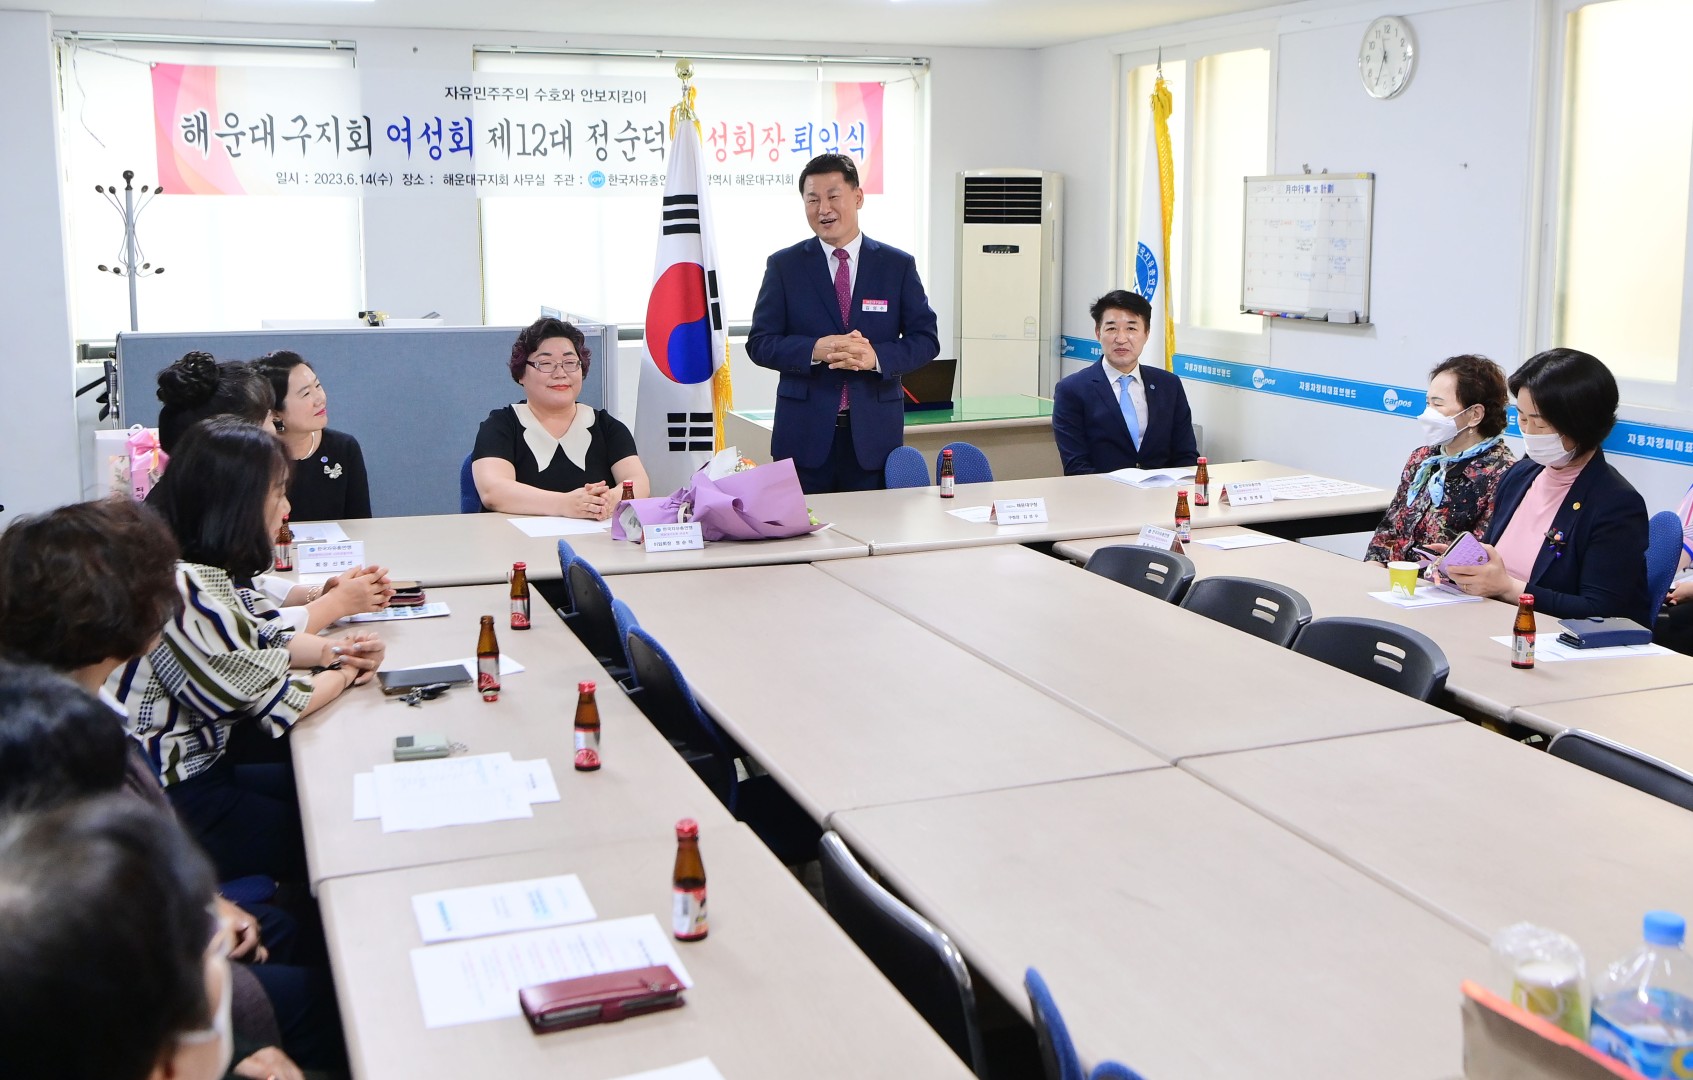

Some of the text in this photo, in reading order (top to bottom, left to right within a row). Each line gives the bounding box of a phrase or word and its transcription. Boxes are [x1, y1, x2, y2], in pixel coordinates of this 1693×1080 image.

[1375, 30, 1381, 39] 11
[1384, 24, 1391, 34] 12
[1369, 41, 1376, 51] 10
[1400, 38, 1405, 47] 2
[1365, 55, 1370, 64] 9
[444, 85, 647, 105] 자유민주주의 수호와 안보지킴이
[180, 110, 865, 163] 해운대구지회 여성회 제12대 정순덕 성회장 퇴임식
[275, 171, 299, 186] 일시
[314, 172, 393, 187] 2023.6.14(수)
[401, 172, 426, 187] 장소
[442, 172, 510, 187] 해운대구지회
[513, 173, 546, 188] 사무실
[553, 173, 575, 187] 주관
[608, 173, 666, 187] 한국자유총
[735, 174, 794, 187] 해운대구지회
[1137, 243, 1156, 296] 국자유총연맹
[1298, 381, 1357, 399] 자동차정비대표브랜드
[1383, 396, 1413, 408] carpos
